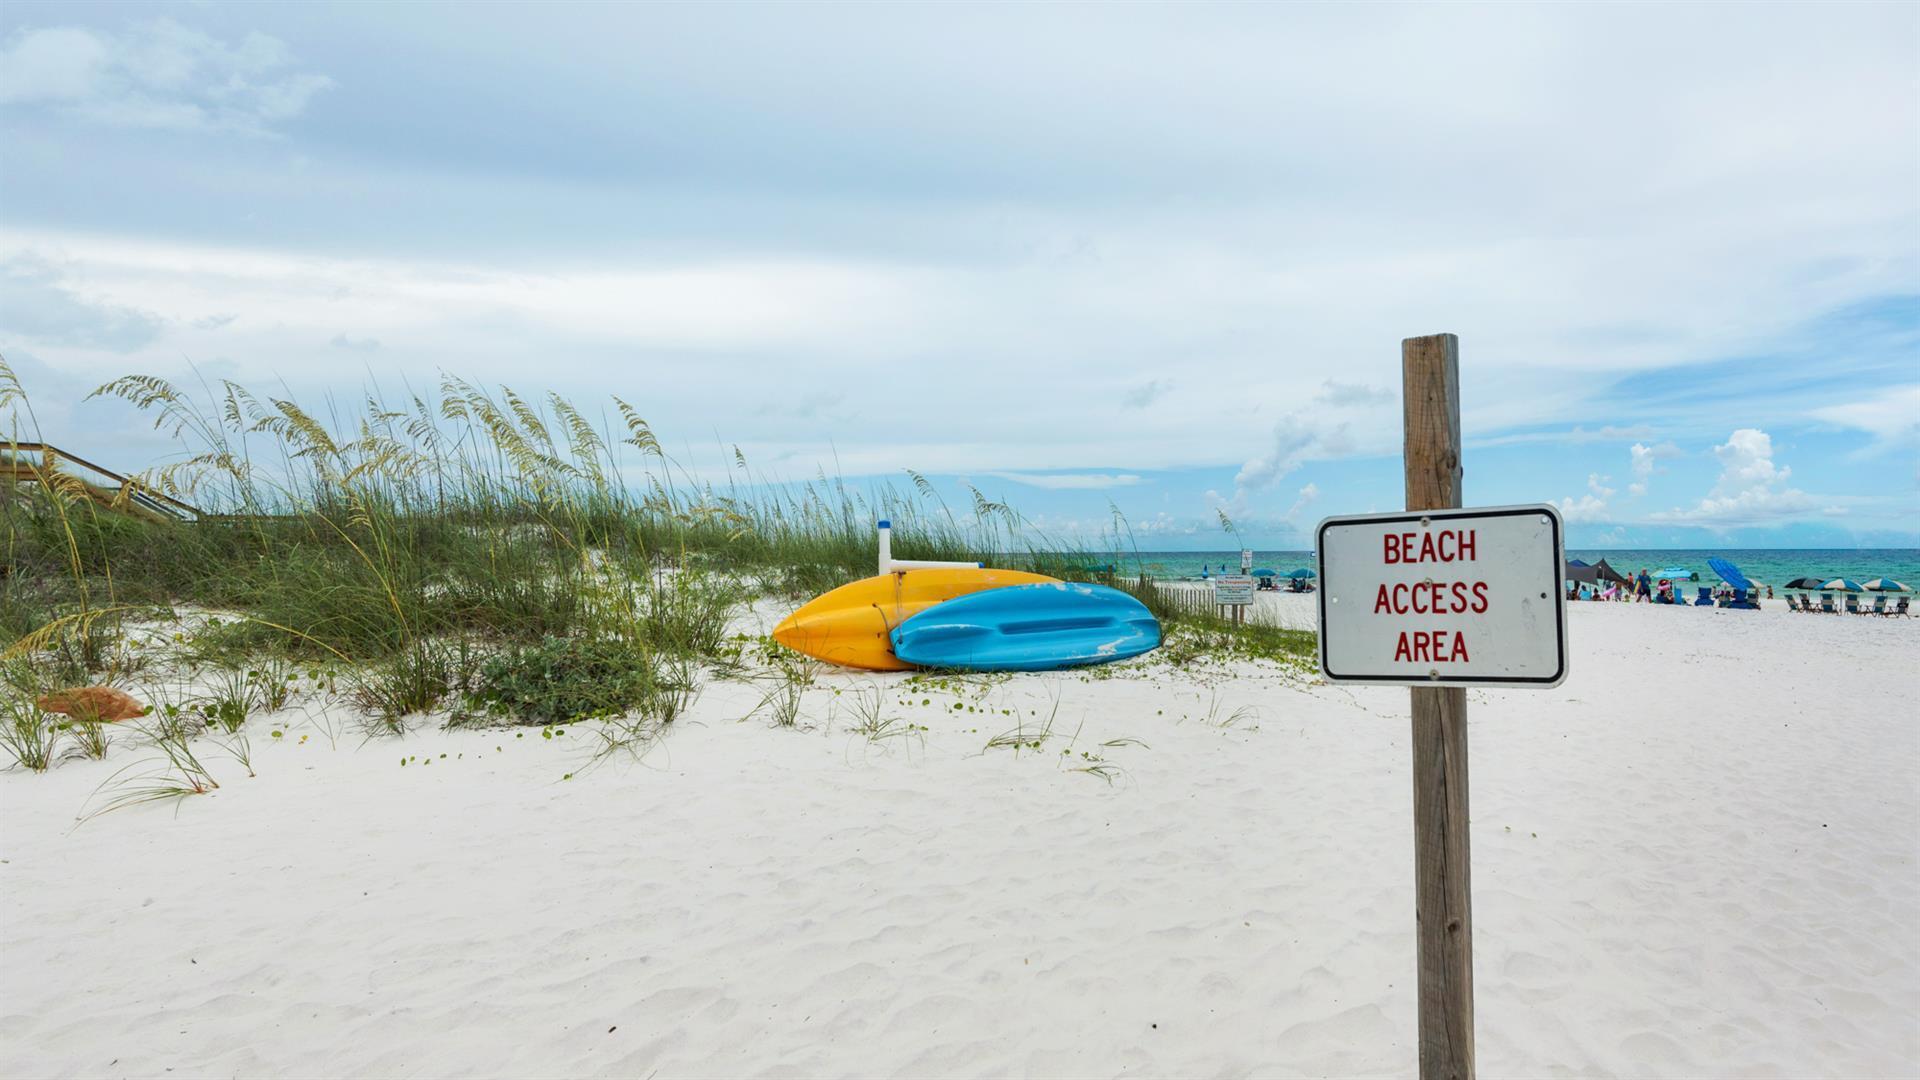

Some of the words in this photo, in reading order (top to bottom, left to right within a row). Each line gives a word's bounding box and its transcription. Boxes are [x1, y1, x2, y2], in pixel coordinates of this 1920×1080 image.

[1384, 530, 1476, 564] BEACH
[1374, 582, 1488, 615] ACCESS
[1394, 631, 1470, 662] AREA
